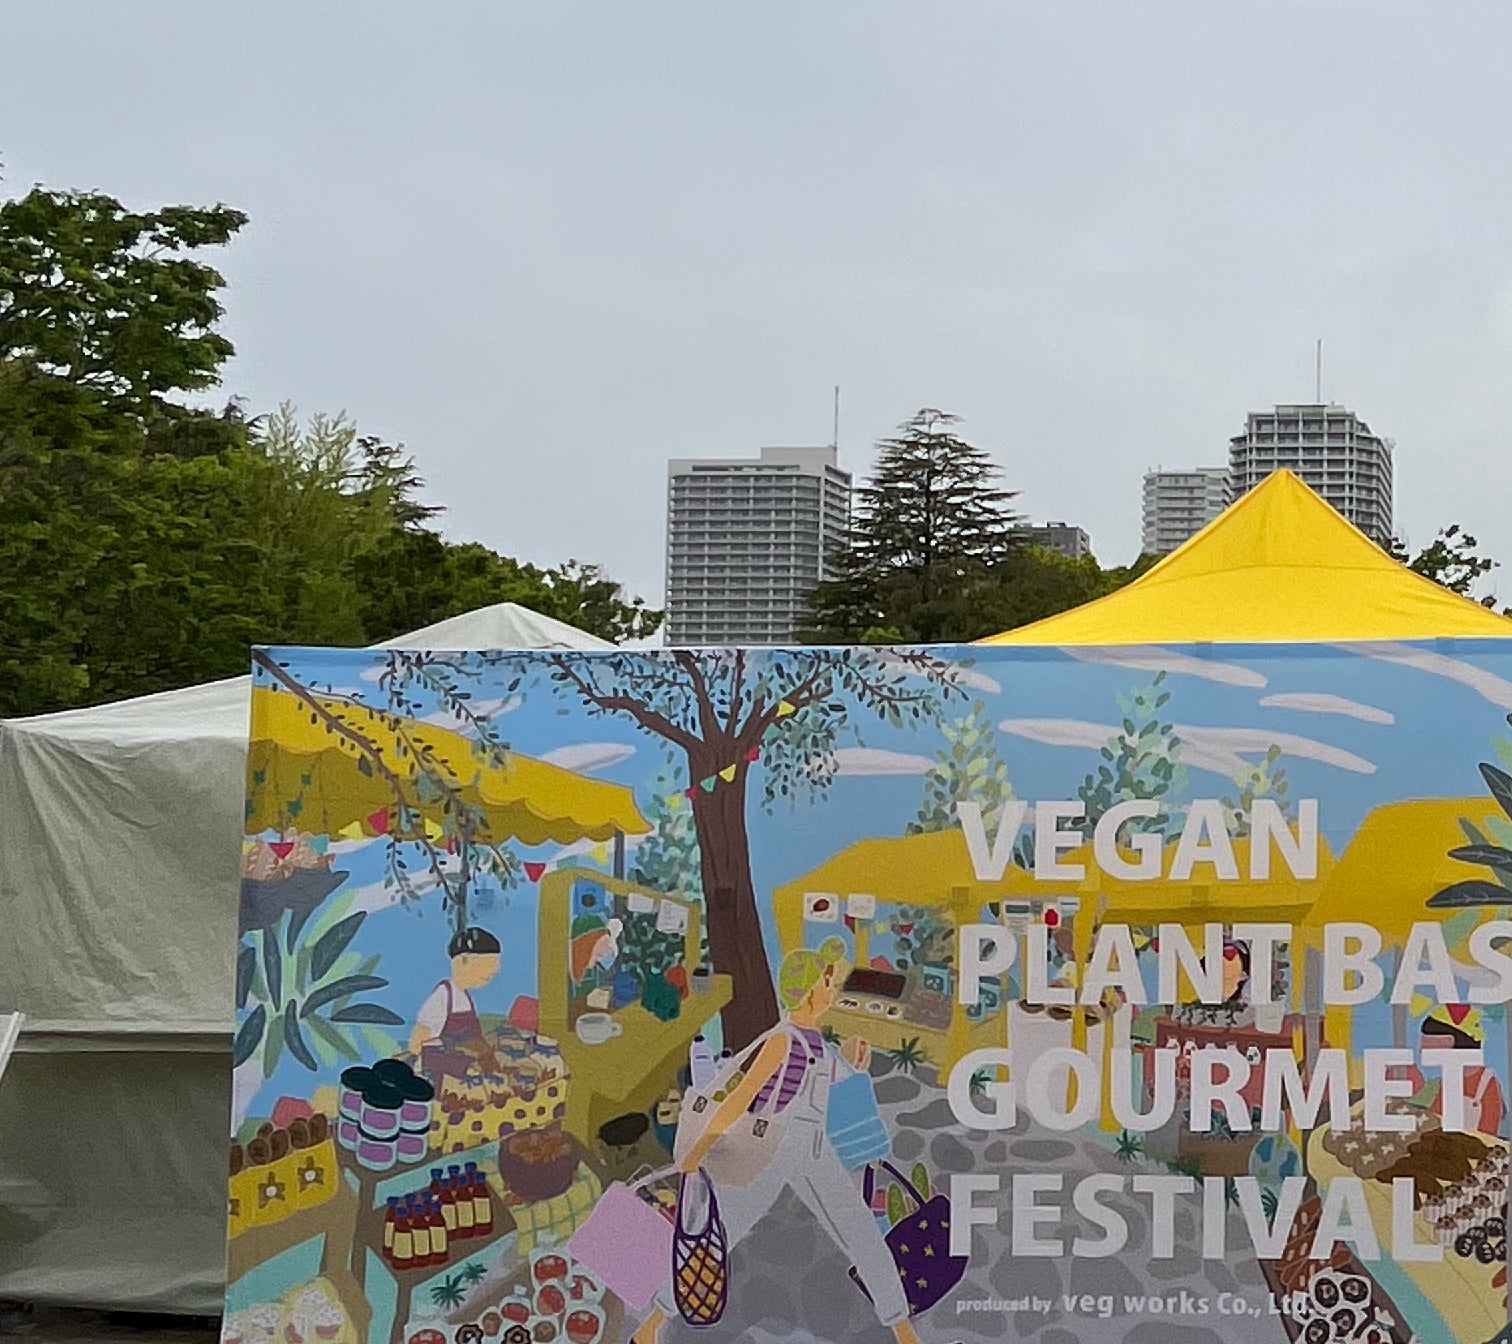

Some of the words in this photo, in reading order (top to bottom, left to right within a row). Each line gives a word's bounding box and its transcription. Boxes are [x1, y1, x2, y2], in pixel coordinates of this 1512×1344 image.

[959, 798, 1319, 882] VEGAN
[957, 921, 1293, 1006] PLANT
[947, 1047, 1485, 1133] GOURMET
[947, 1173, 1447, 1261] FESTIVAL
[956, 1296, 1029, 1315] produced
[1032, 1296, 1052, 1313] by
[1062, 1293, 1114, 1318] veg
[1123, 1291, 1209, 1314] works
[1216, 1293, 1261, 1319] Co.,
[1268, 1291, 1314, 1315] Ltd.
